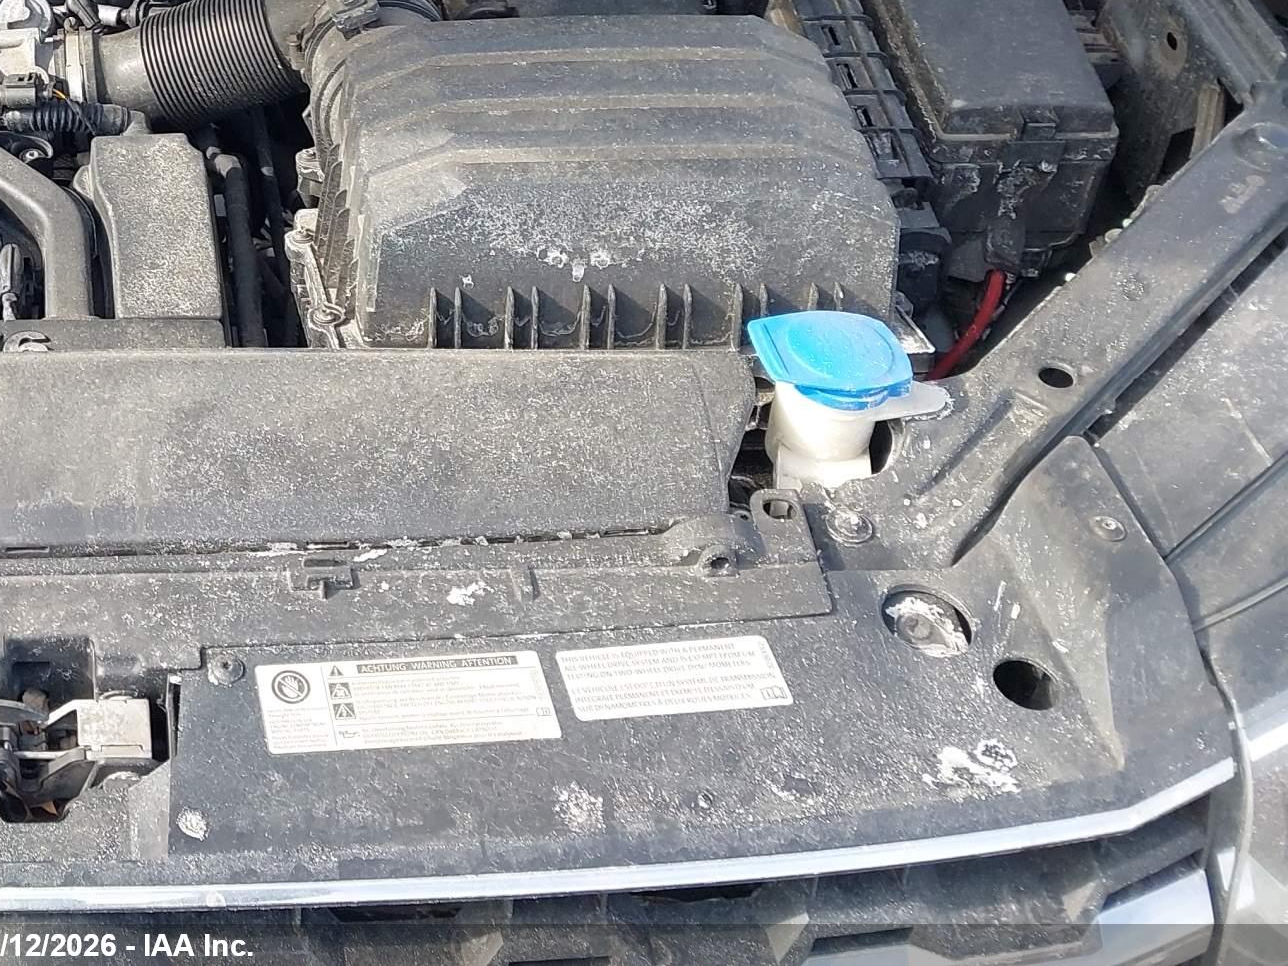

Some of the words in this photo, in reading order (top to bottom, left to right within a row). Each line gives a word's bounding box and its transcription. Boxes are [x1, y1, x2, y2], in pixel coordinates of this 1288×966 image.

[689, 642, 735, 652] PERMANENT
[360, 663, 407, 673] ACHTUNG
[409, 660, 457, 670] WARNING
[460, 656, 512, 666] ATTENTION
